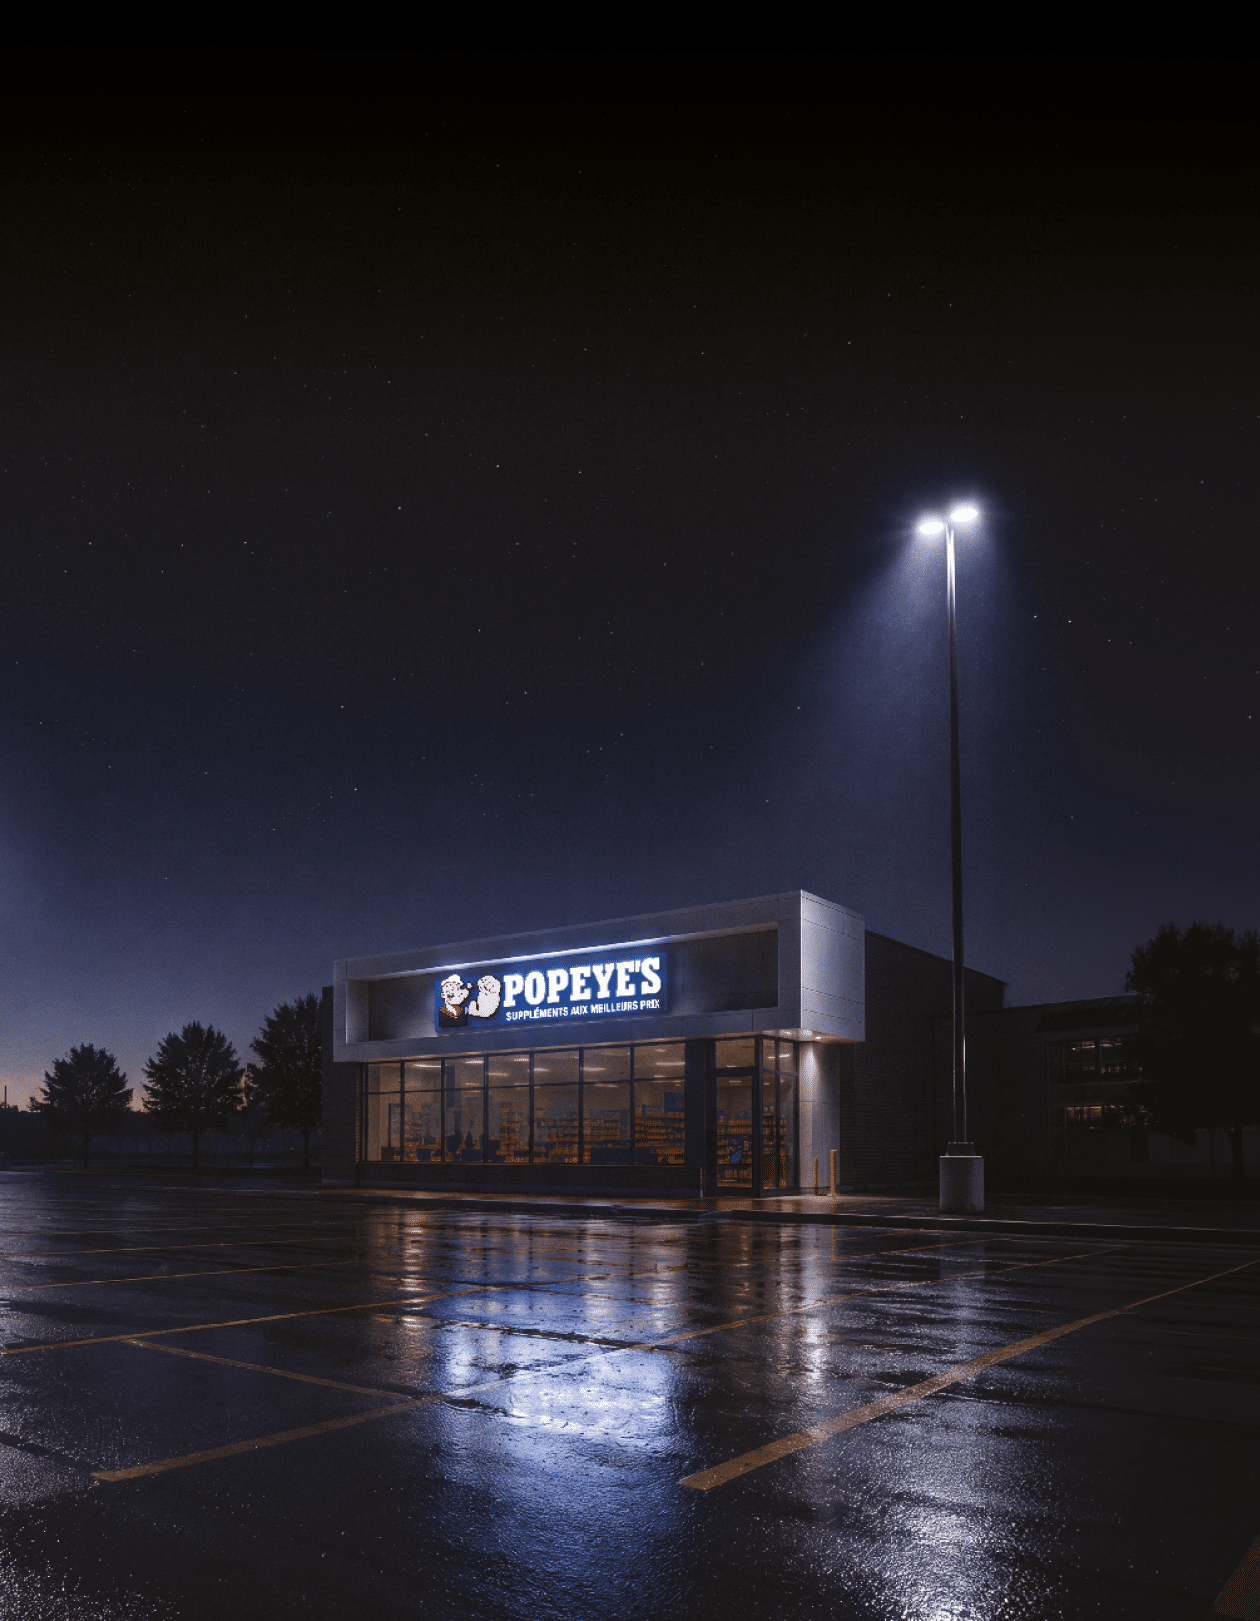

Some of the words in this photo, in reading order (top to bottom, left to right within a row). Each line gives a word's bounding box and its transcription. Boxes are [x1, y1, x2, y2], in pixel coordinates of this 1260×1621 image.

[503, 957, 661, 1007] POPEYE'S
[506, 1006, 568, 1021] SUPPLÉMENTS
[570, 1005, 588, 1015] AUX
[590, 1001, 638, 1013] MEILLEURS
[640, 999, 660, 1009] PRIX
